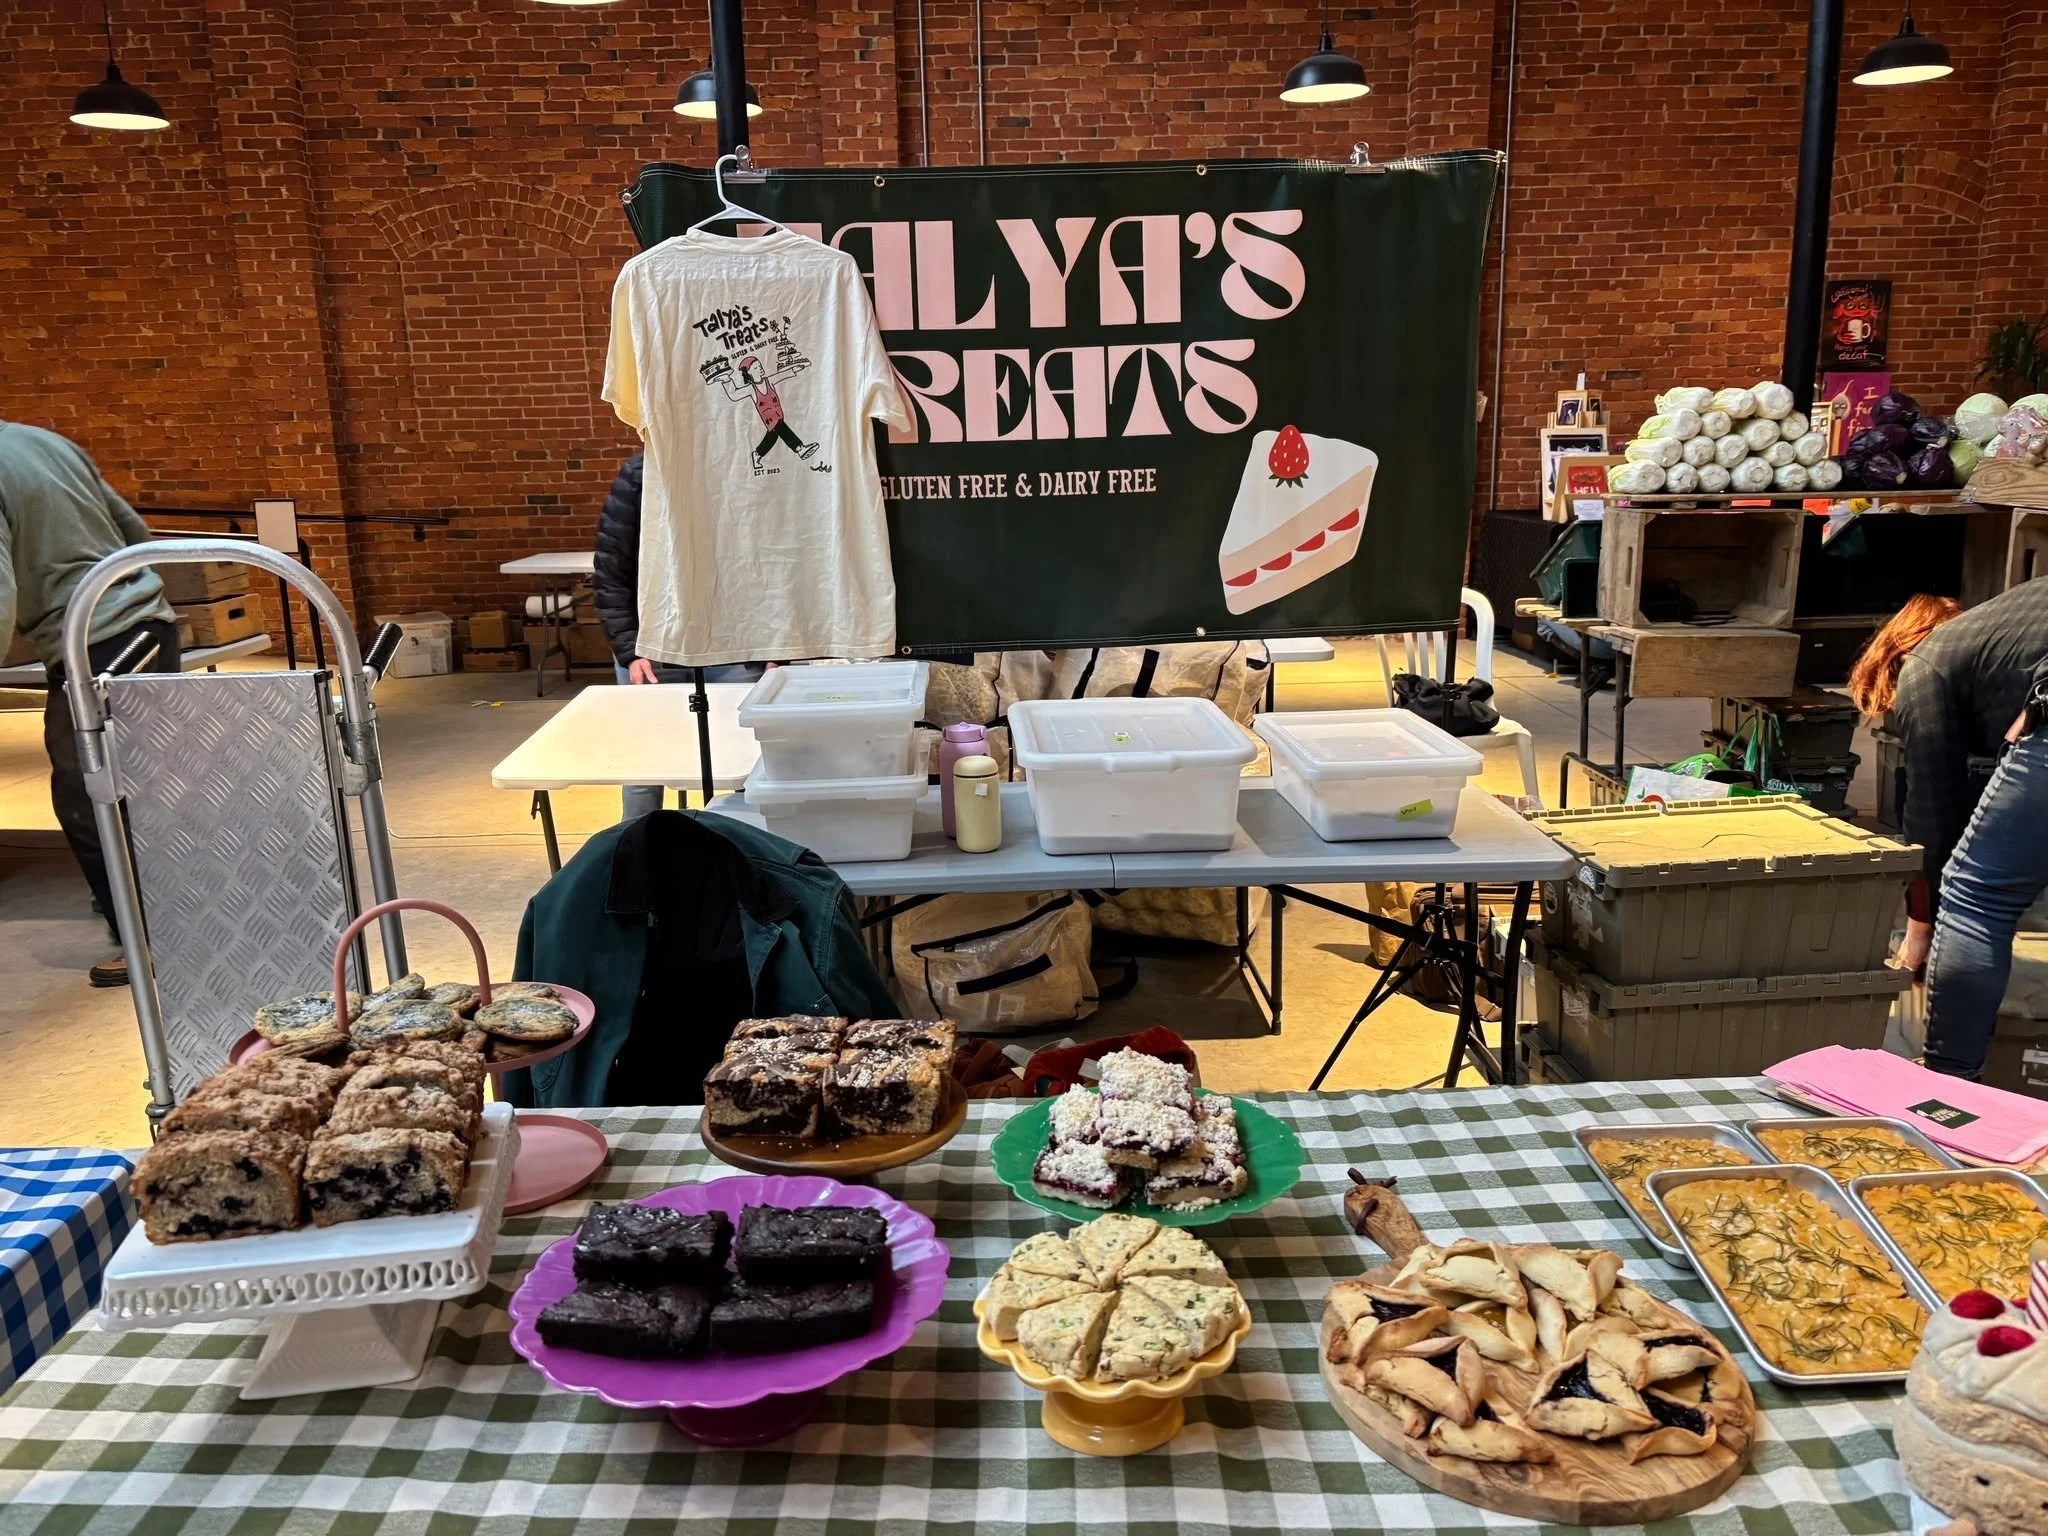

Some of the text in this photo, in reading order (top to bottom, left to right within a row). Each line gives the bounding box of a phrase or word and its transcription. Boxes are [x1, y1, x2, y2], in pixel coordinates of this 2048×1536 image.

[692, 304, 753, 338] Talya's
[715, 317, 770, 350] Treats
[731, 348, 748, 361] GLUTEN
[754, 340, 768, 350] DAIRY
[768, 335, 779, 345] FREE
[1838, 349, 1871, 361] decaf
[885, 338, 1258, 445] REATS
[1863, 386, 1880, 400] I
[754, 469, 765, 477] EST
[879, 468, 1157, 500] GLUTEN FREE & DAIRY FREE
